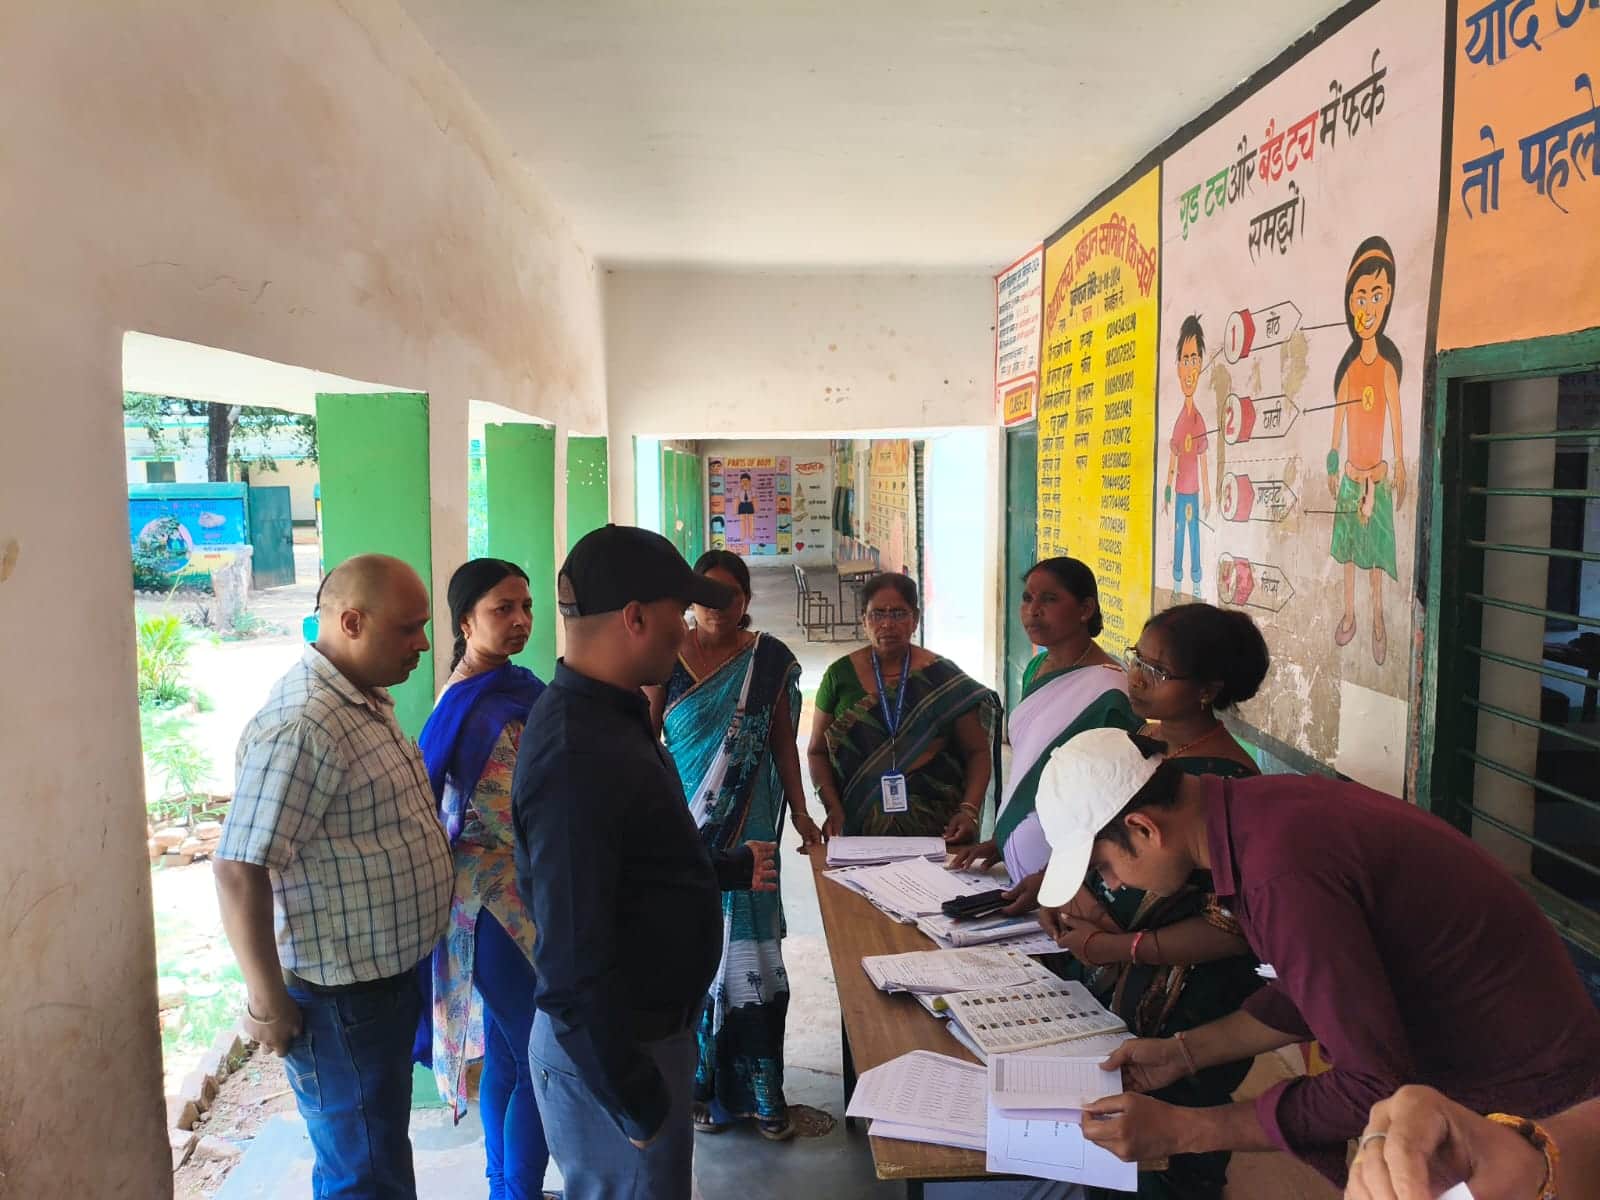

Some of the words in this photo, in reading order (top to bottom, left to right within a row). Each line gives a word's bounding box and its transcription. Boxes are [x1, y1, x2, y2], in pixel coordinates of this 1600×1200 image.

[1179, 184, 1201, 240] गुड
[1205, 167, 1229, 217] टच
[1228, 135, 1257, 204] और
[1285, 110, 1319, 172] टच
[1320, 80, 1342, 148] में
[1341, 49, 1387, 140] फर्क
[1462, 125, 1504, 219] तो
[1518, 73, 1600, 213] पहले
[1231, 325, 1236, 351] 1
[1225, 407, 1235, 435] 2
[1224, 482, 1233, 513] 3
